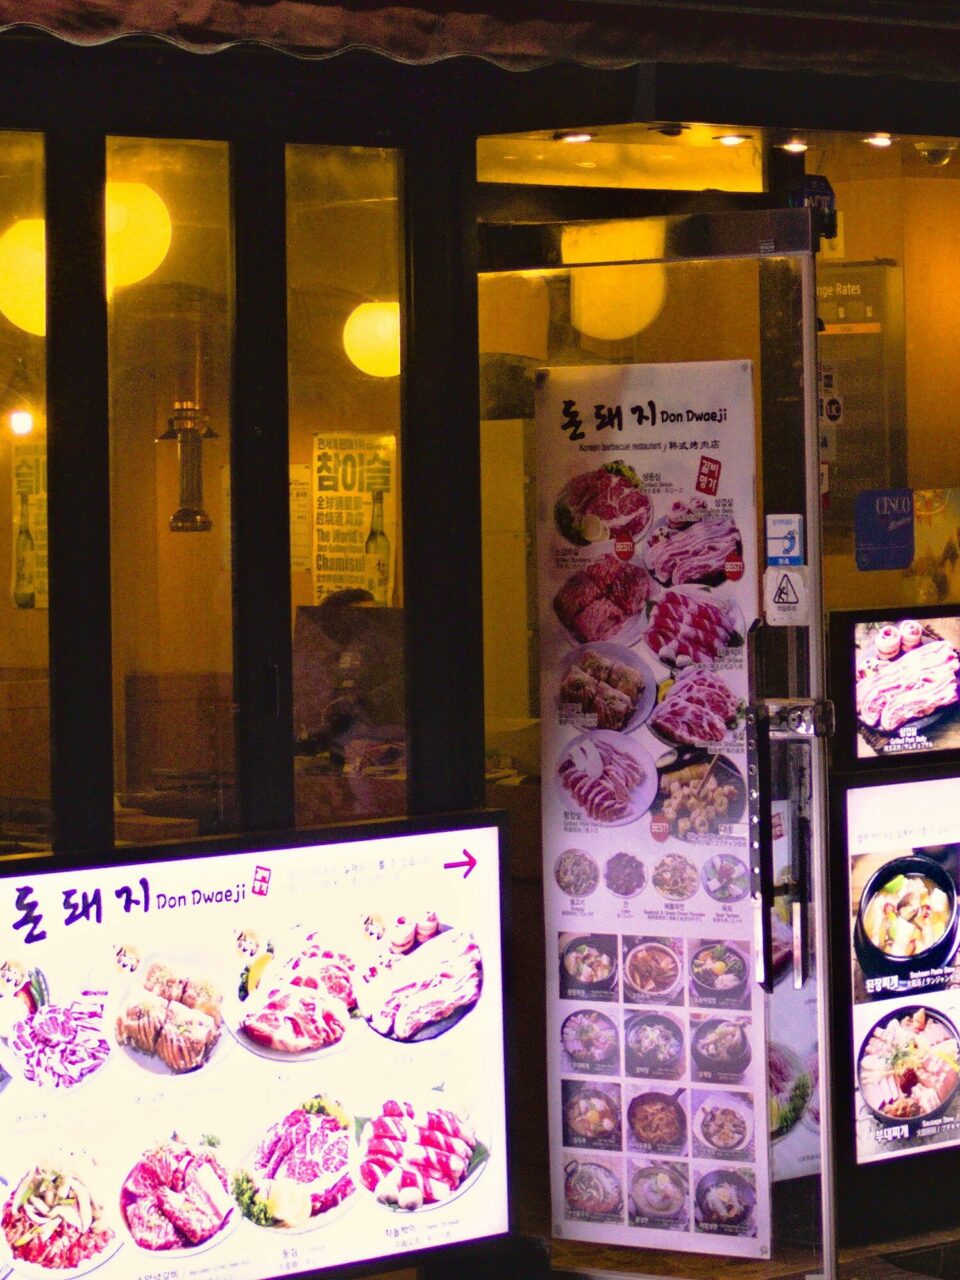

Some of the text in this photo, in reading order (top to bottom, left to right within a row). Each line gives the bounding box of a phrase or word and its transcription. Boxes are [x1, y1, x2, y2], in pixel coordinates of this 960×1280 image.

[836, 282, 861, 296] Rates
[661, 410, 683, 423] Don
[686, 408, 728, 423] Dwaeji
[317, 451, 391, 493] 참이슬
[316, 553, 365, 572] Chamisul
[156, 891, 188, 910] Don
[191, 883, 247, 908] Dwaeji
